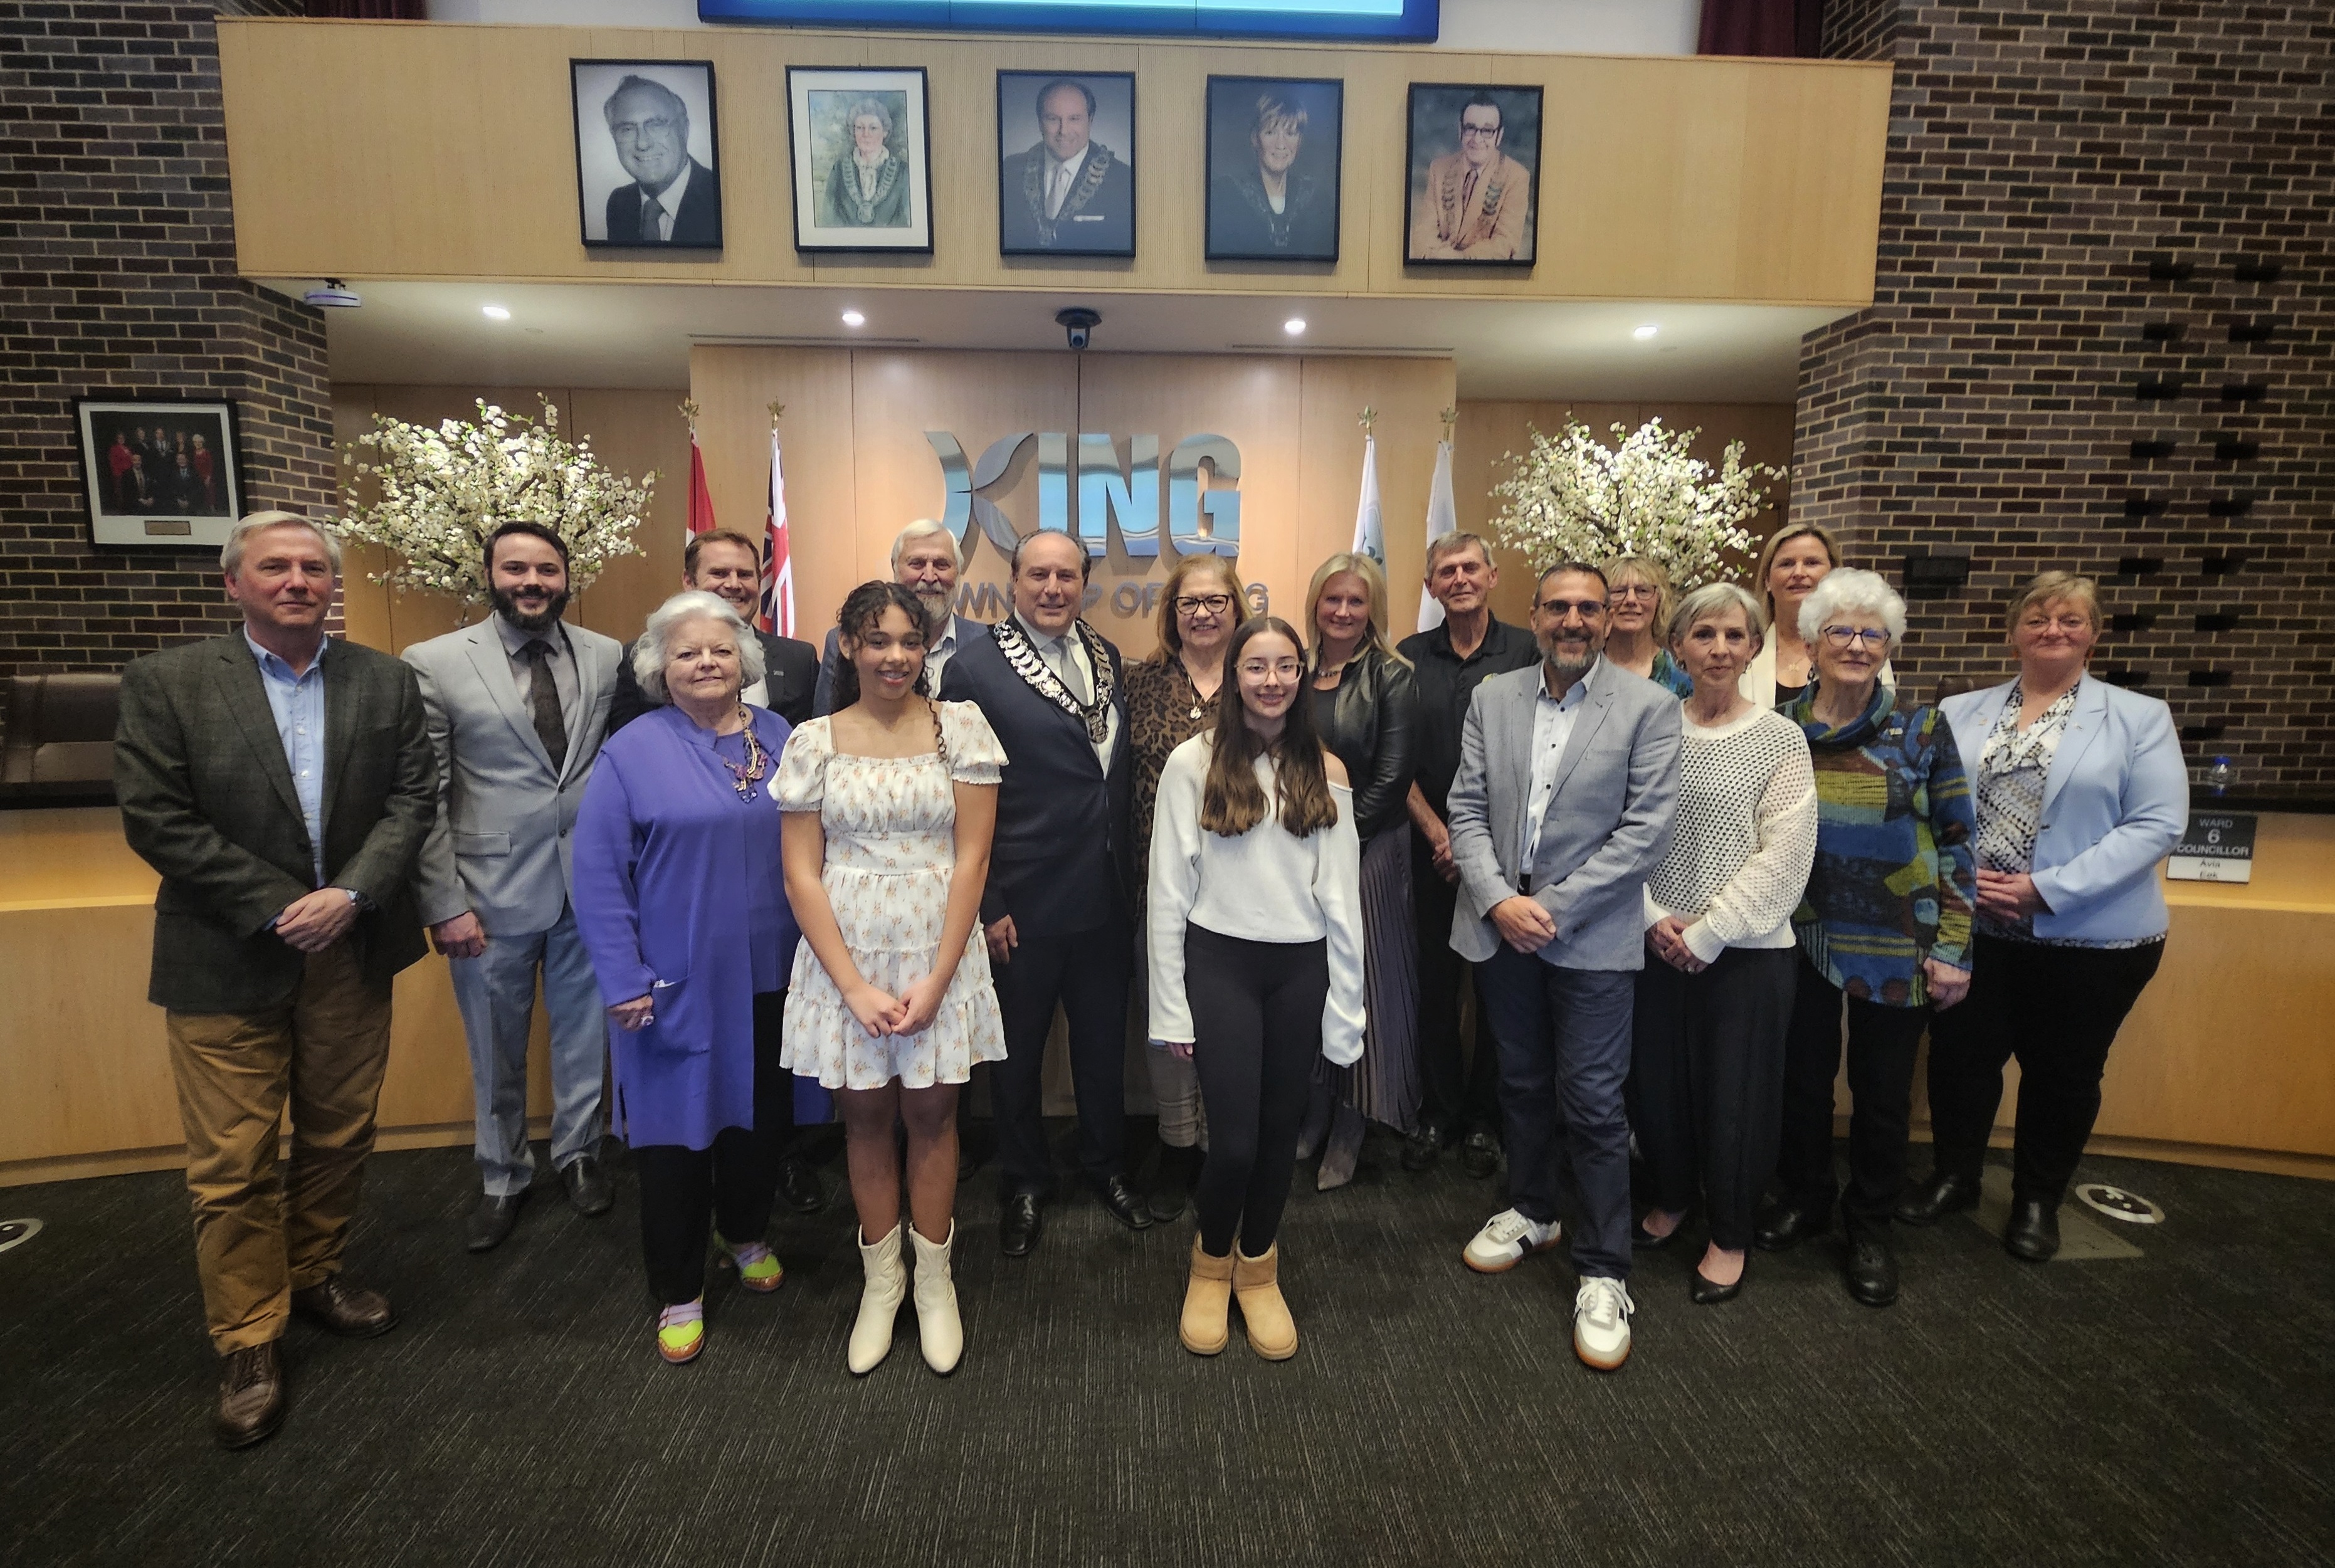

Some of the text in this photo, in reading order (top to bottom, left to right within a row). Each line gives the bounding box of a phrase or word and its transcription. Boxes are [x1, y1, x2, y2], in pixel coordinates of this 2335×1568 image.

[924, 430, 1241, 557] KING
[2199, 818, 2233, 828] WARD
[2208, 828, 2220, 845] 6
[2177, 844, 2249, 856] COUNCILLOR
